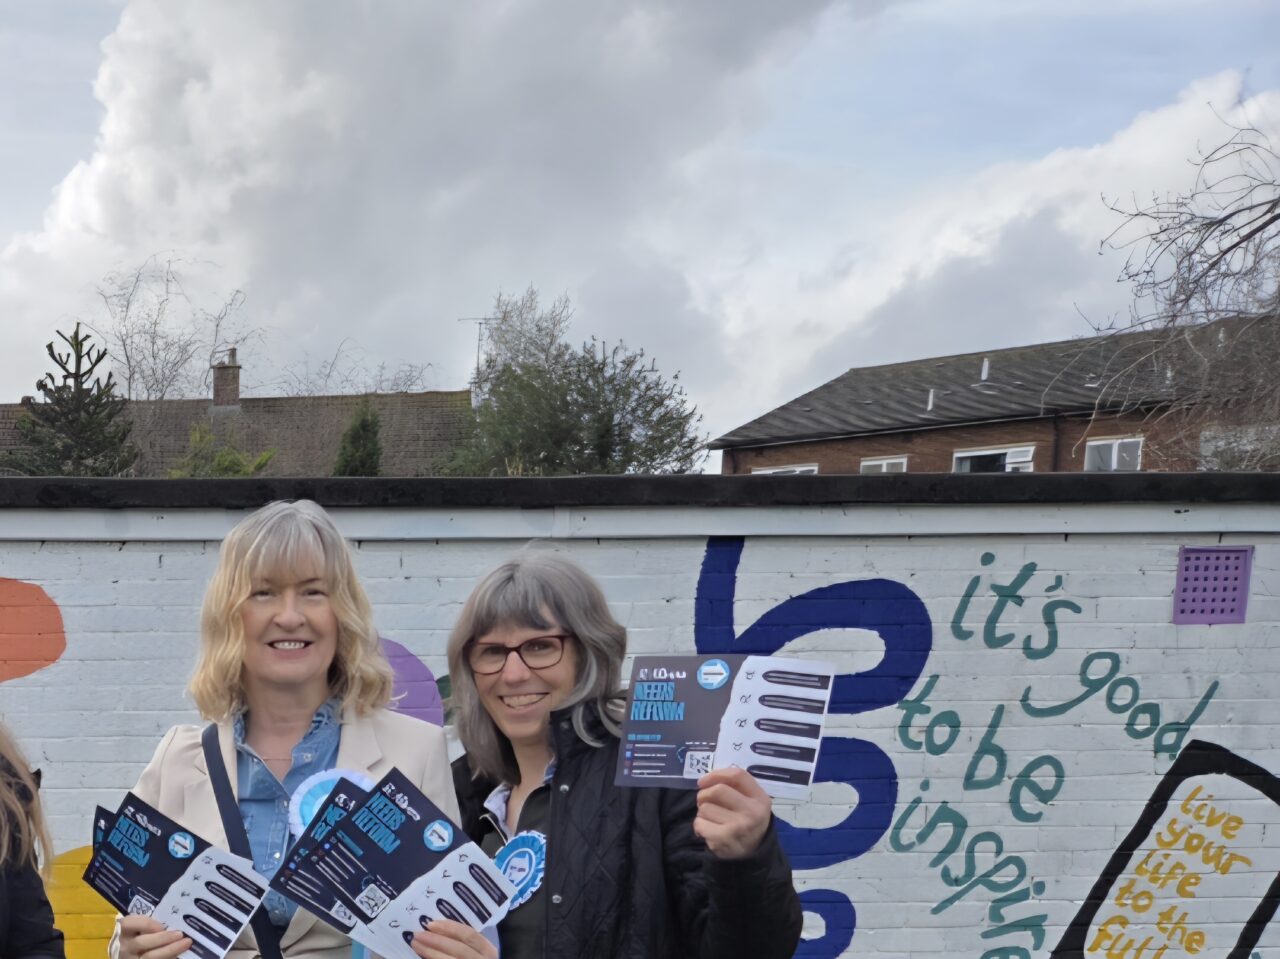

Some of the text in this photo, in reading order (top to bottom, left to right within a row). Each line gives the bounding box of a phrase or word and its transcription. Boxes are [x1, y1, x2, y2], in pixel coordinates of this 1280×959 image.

[950, 552, 1219, 759] it's good
[897, 674, 1065, 822] to be
[1156, 818, 1252, 875] your
[1115, 879, 1206, 955] to the
